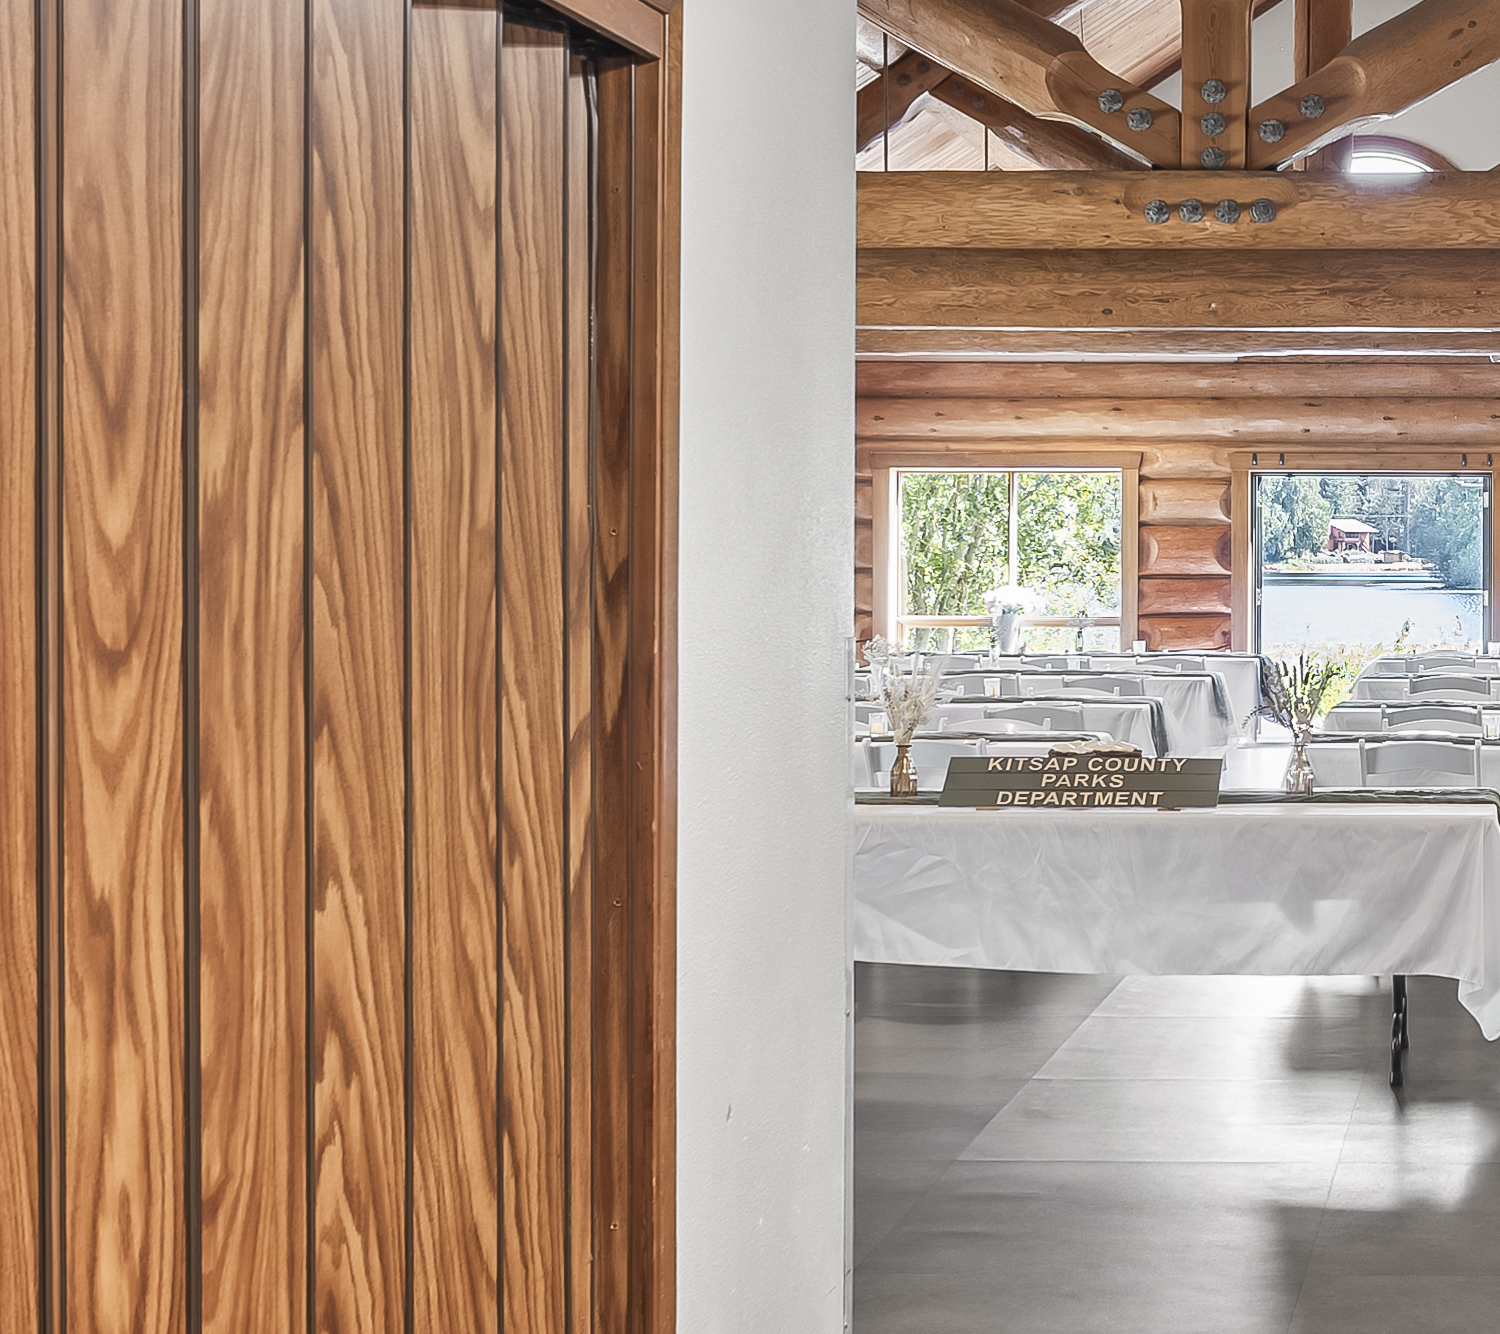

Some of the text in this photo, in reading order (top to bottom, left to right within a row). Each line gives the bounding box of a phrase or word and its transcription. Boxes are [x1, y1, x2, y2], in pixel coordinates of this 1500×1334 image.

[987, 757, 1188, 772] KITSAP COUNTY
[1040, 774, 1125, 788] PARKS
[996, 791, 1164, 806] DEPARTMENT
